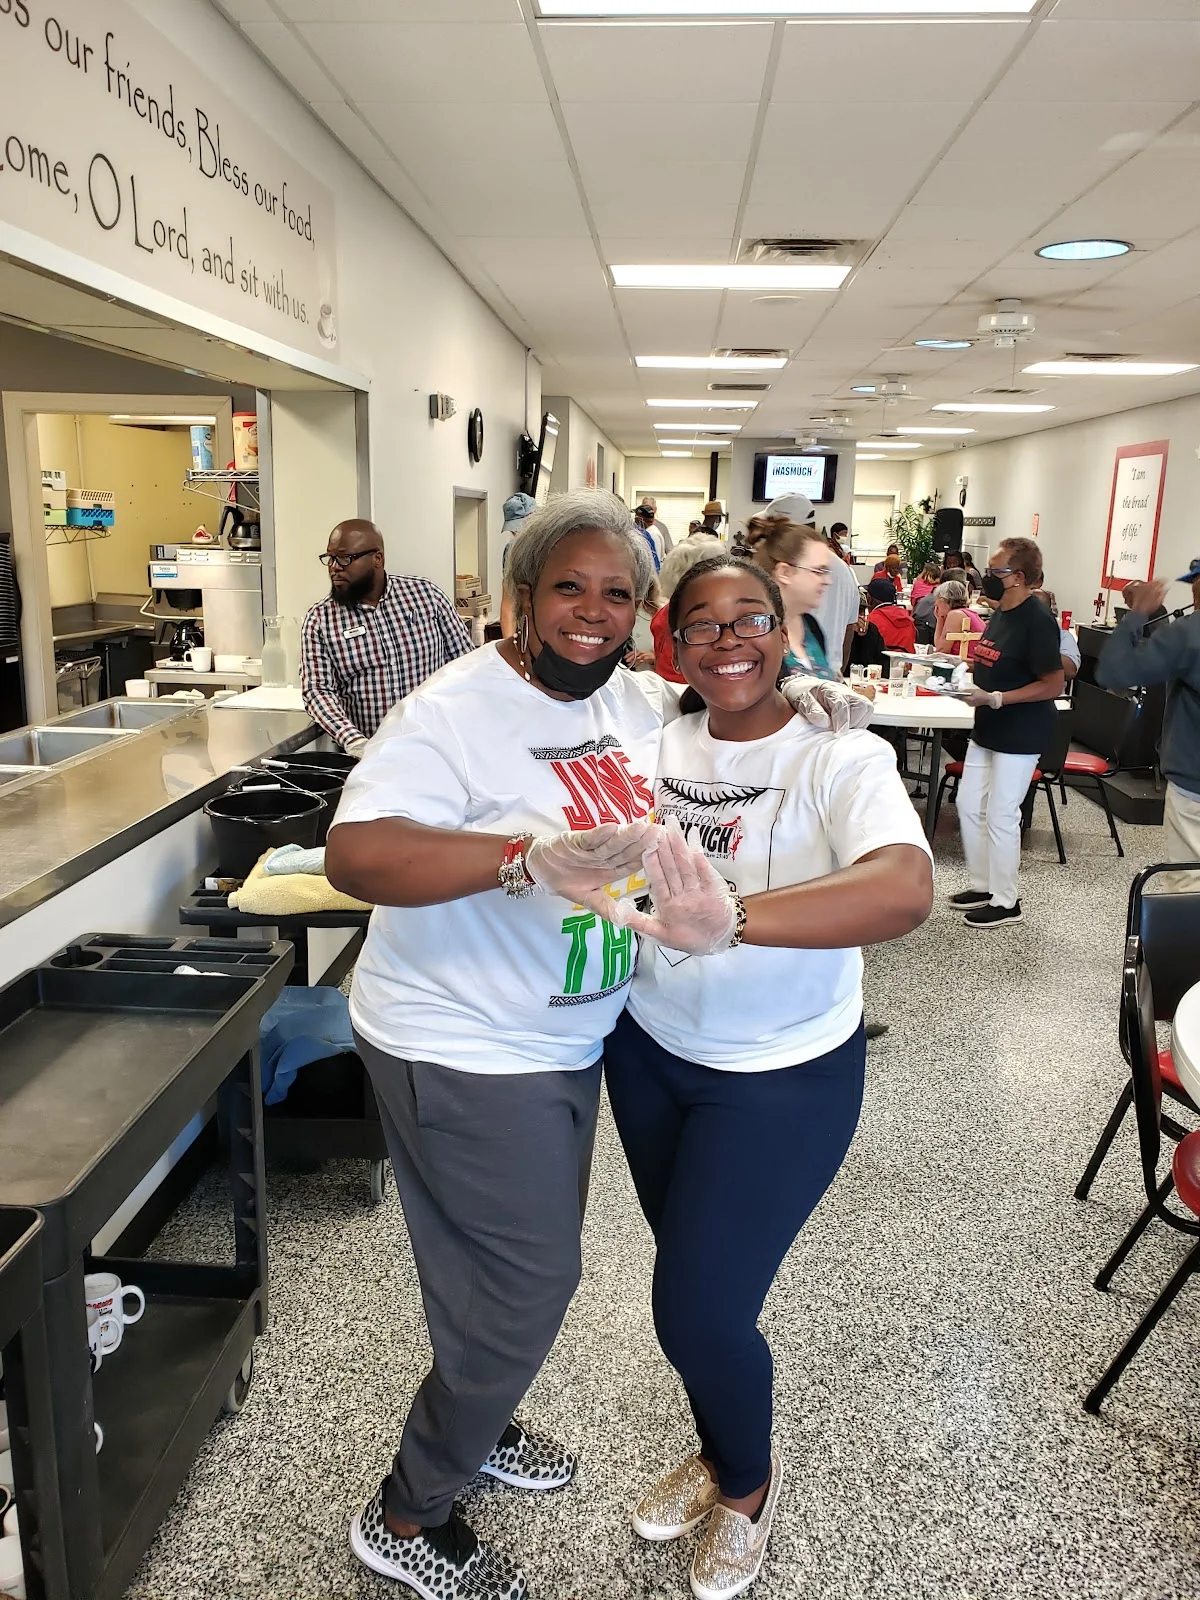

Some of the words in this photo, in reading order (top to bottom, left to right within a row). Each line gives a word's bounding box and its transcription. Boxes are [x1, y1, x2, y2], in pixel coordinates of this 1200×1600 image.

[44, 17, 94, 73] our
[104, 32, 192, 163] friends,
[195, 107, 249, 196] Bless
[254, 183, 278, 215] our
[282, 182, 316, 251] food,
[0, 135, 78, 214] ome,
[88, 153, 121, 231] O
[131, 174, 195, 274] Lord,
[202, 236, 235, 285] and
[240, 259, 259, 298] sit
[263, 268, 290, 316] with
[292, 298, 310, 325] us.
[772, 466, 813, 476] INASMUCH
[1136, 470, 1146, 480] am
[1122, 495, 1131, 509] the
[1131, 494, 1151, 509] bread
[1122, 524, 1129, 541] of
[561, 911, 633, 995] TH
